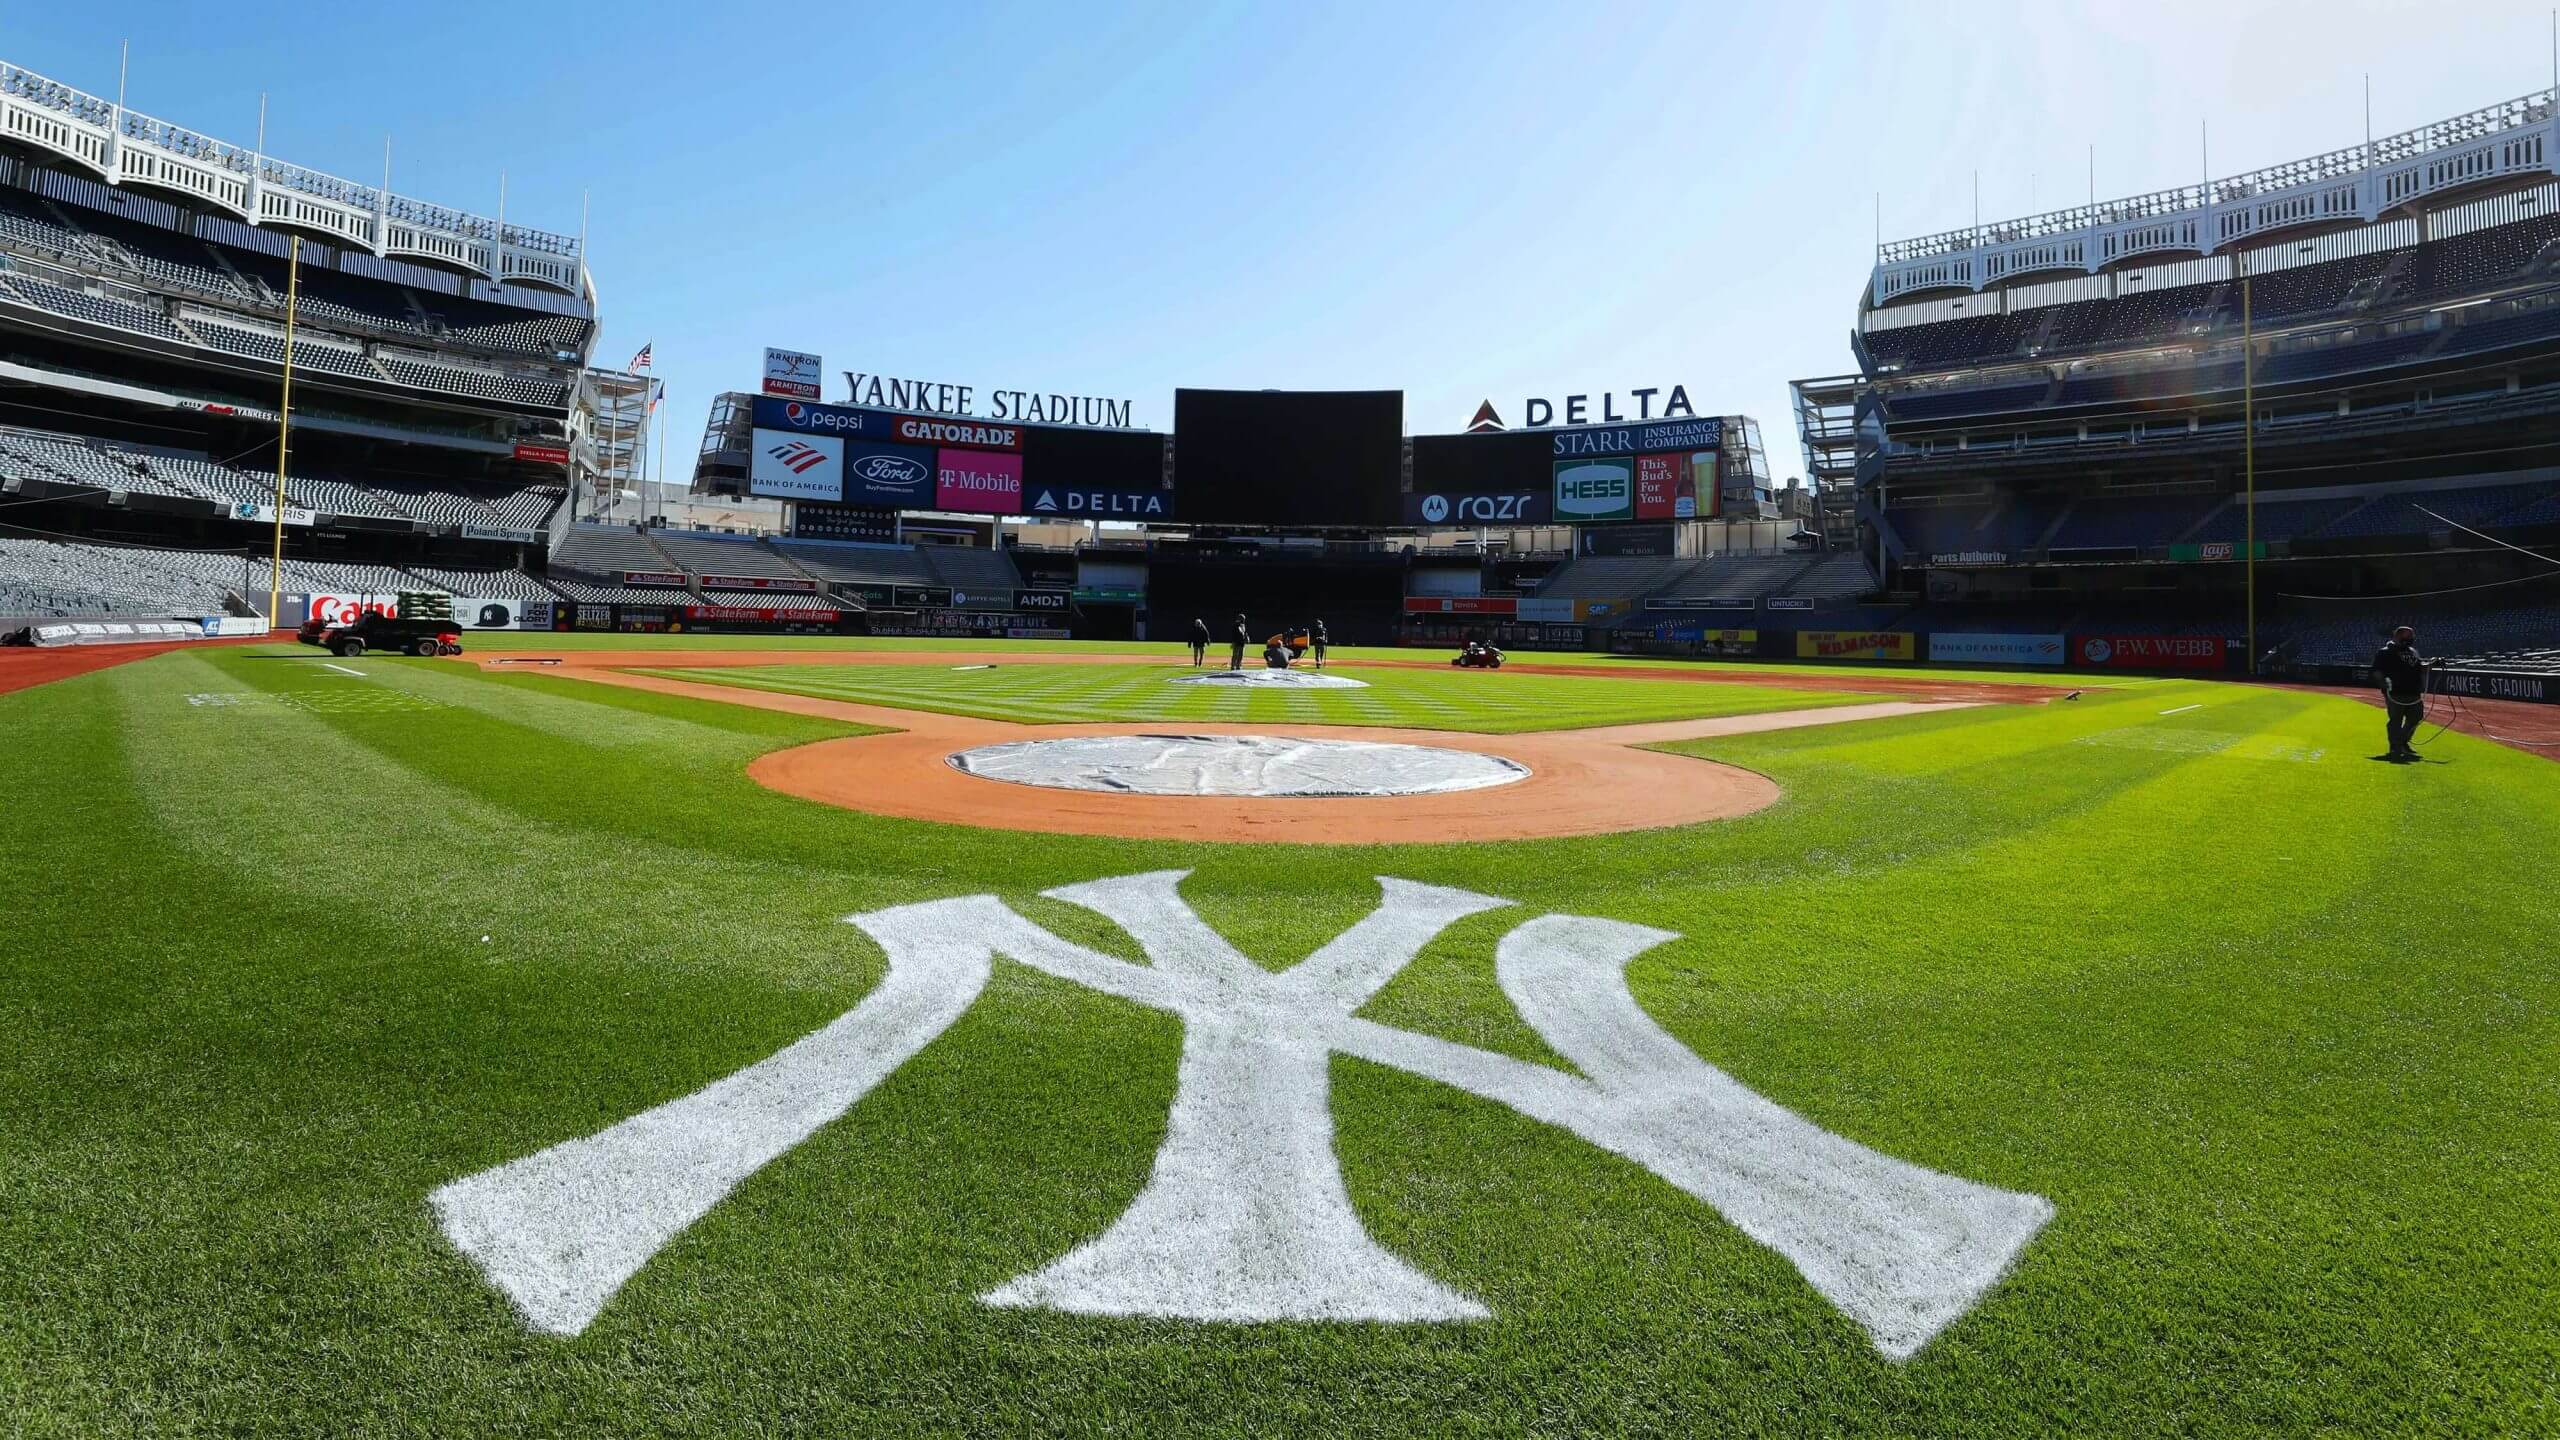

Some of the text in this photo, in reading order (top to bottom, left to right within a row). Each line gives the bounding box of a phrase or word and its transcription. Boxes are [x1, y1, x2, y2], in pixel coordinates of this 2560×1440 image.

[768, 351, 820, 367] ARMITRON
[770, 380, 816, 393] ARMITRON
[842, 371, 1133, 428] YANKEE STADIUM
[1526, 384, 1696, 427] DELTA
[237, 407, 272, 421] YANKEES
[811, 412, 863, 431] pepsi
[901, 420, 1016, 447] GATORADE
[1645, 421, 1720, 438] INSURANCE
[1554, 430, 1635, 455] STARR
[1645, 433, 1720, 449] COMPANIES
[867, 458, 915, 481] Ford
[1640, 459, 1667, 469] This
[959, 470, 1021, 493] Mobile
[1641, 470, 1673, 481] Bud's
[752, 478, 841, 493] BANK OF AMERICA
[1561, 479, 1626, 500] HESS
[1640, 483, 1661, 493] For
[1068, 493, 1163, 513] DELTA
[1640, 494, 1666, 504] You.
[1458, 495, 1532, 520] razr
[466, 525, 531, 541] Poland Spring
[1932, 550, 2008, 562] Parts Authority
[1021, 595, 1052, 606] AMD
[577, 609, 611, 619] SELTZER
[1932, 643, 2033, 654] BANK OF AMERICA
[2115, 639, 2215, 657] F.W. WEBB
[2490, 677, 2544, 698] STADIUM
[429, 867, 2056, 1361] NY
